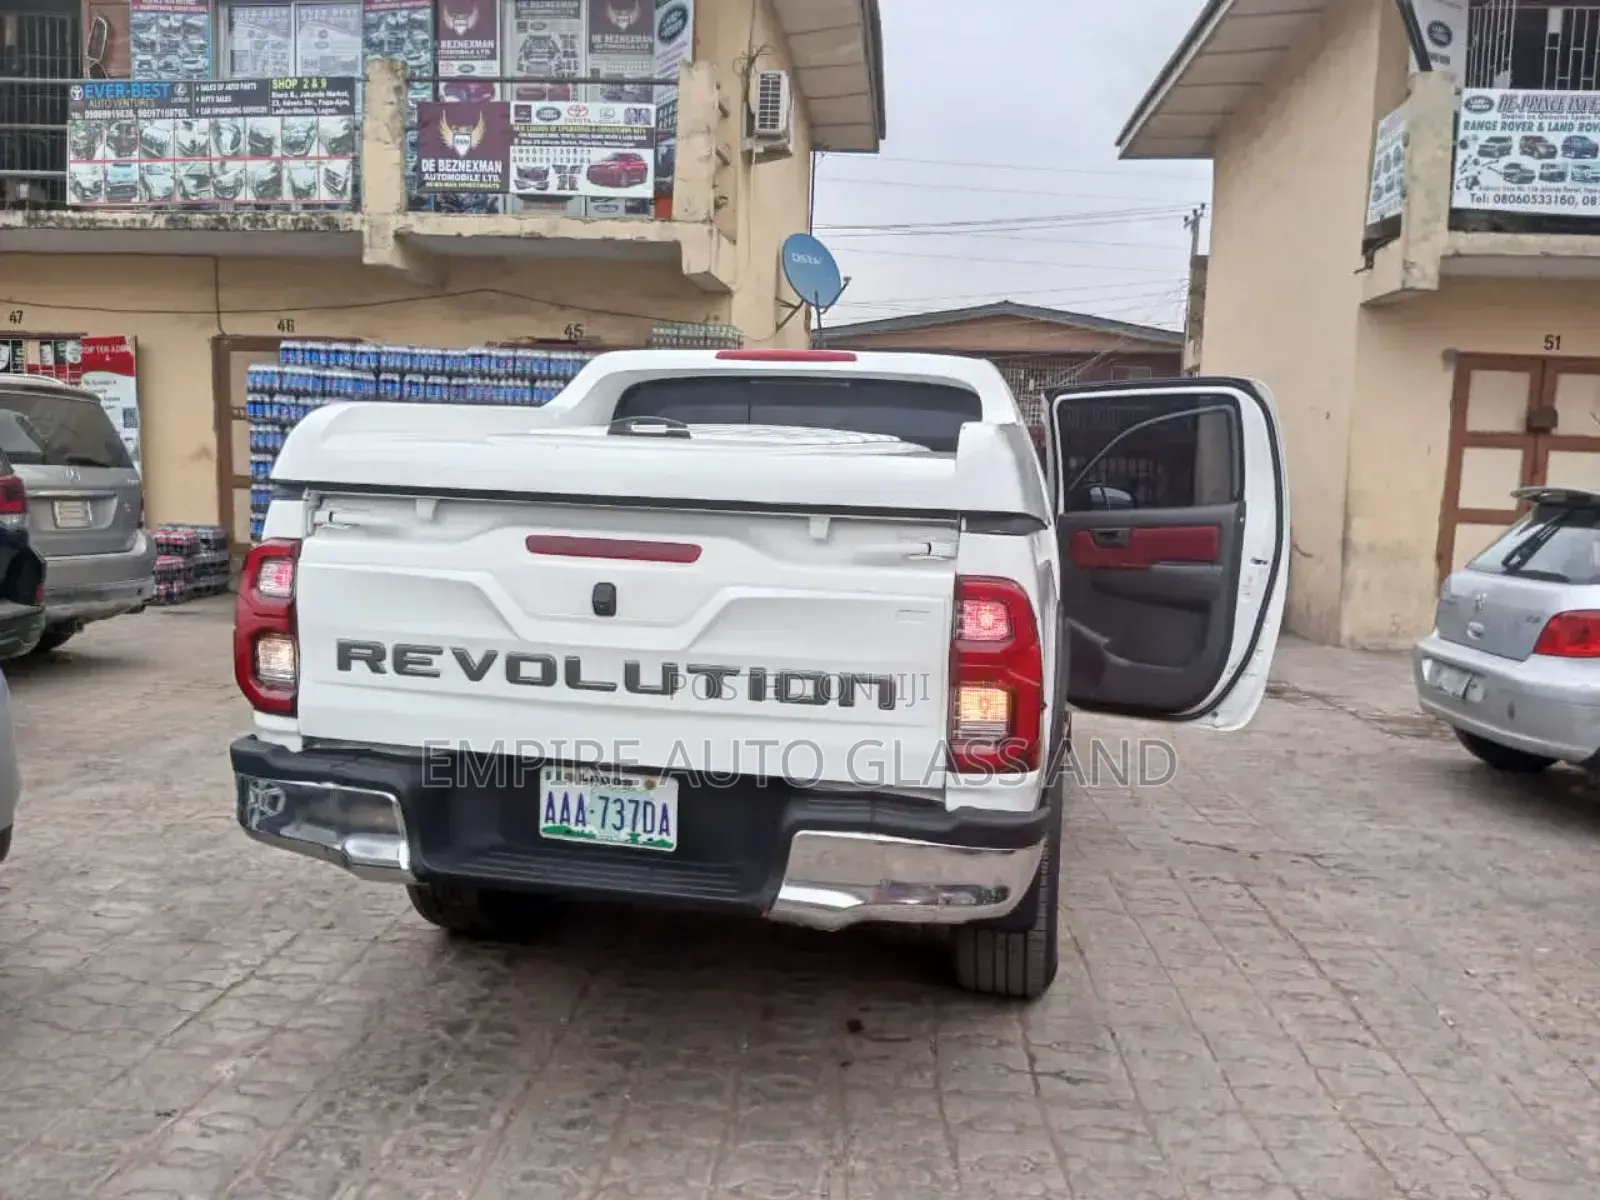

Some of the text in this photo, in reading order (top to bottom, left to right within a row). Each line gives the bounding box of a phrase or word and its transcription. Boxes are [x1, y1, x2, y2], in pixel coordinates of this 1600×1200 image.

[271, 77, 298, 90] SHOP
[302, 78, 309, 89] 2
[84, 83, 171, 99] EVER-BEST
[1463, 121, 1600, 132] RANGE ROVER & LAND ROV
[421, 159, 436, 172] DE
[438, 159, 502, 173] BEZNEXMAN
[423, 174, 481, 182] AUTOMOBILE
[1470, 194, 1489, 205] Tel:
[1582, 195, 1600, 206] 08
[9, 310, 23, 324] 47
[1543, 334, 1561, 351] 51
[336, 638, 896, 711] REVOLUTION
[543, 790, 671, 837] AAA-737DA
